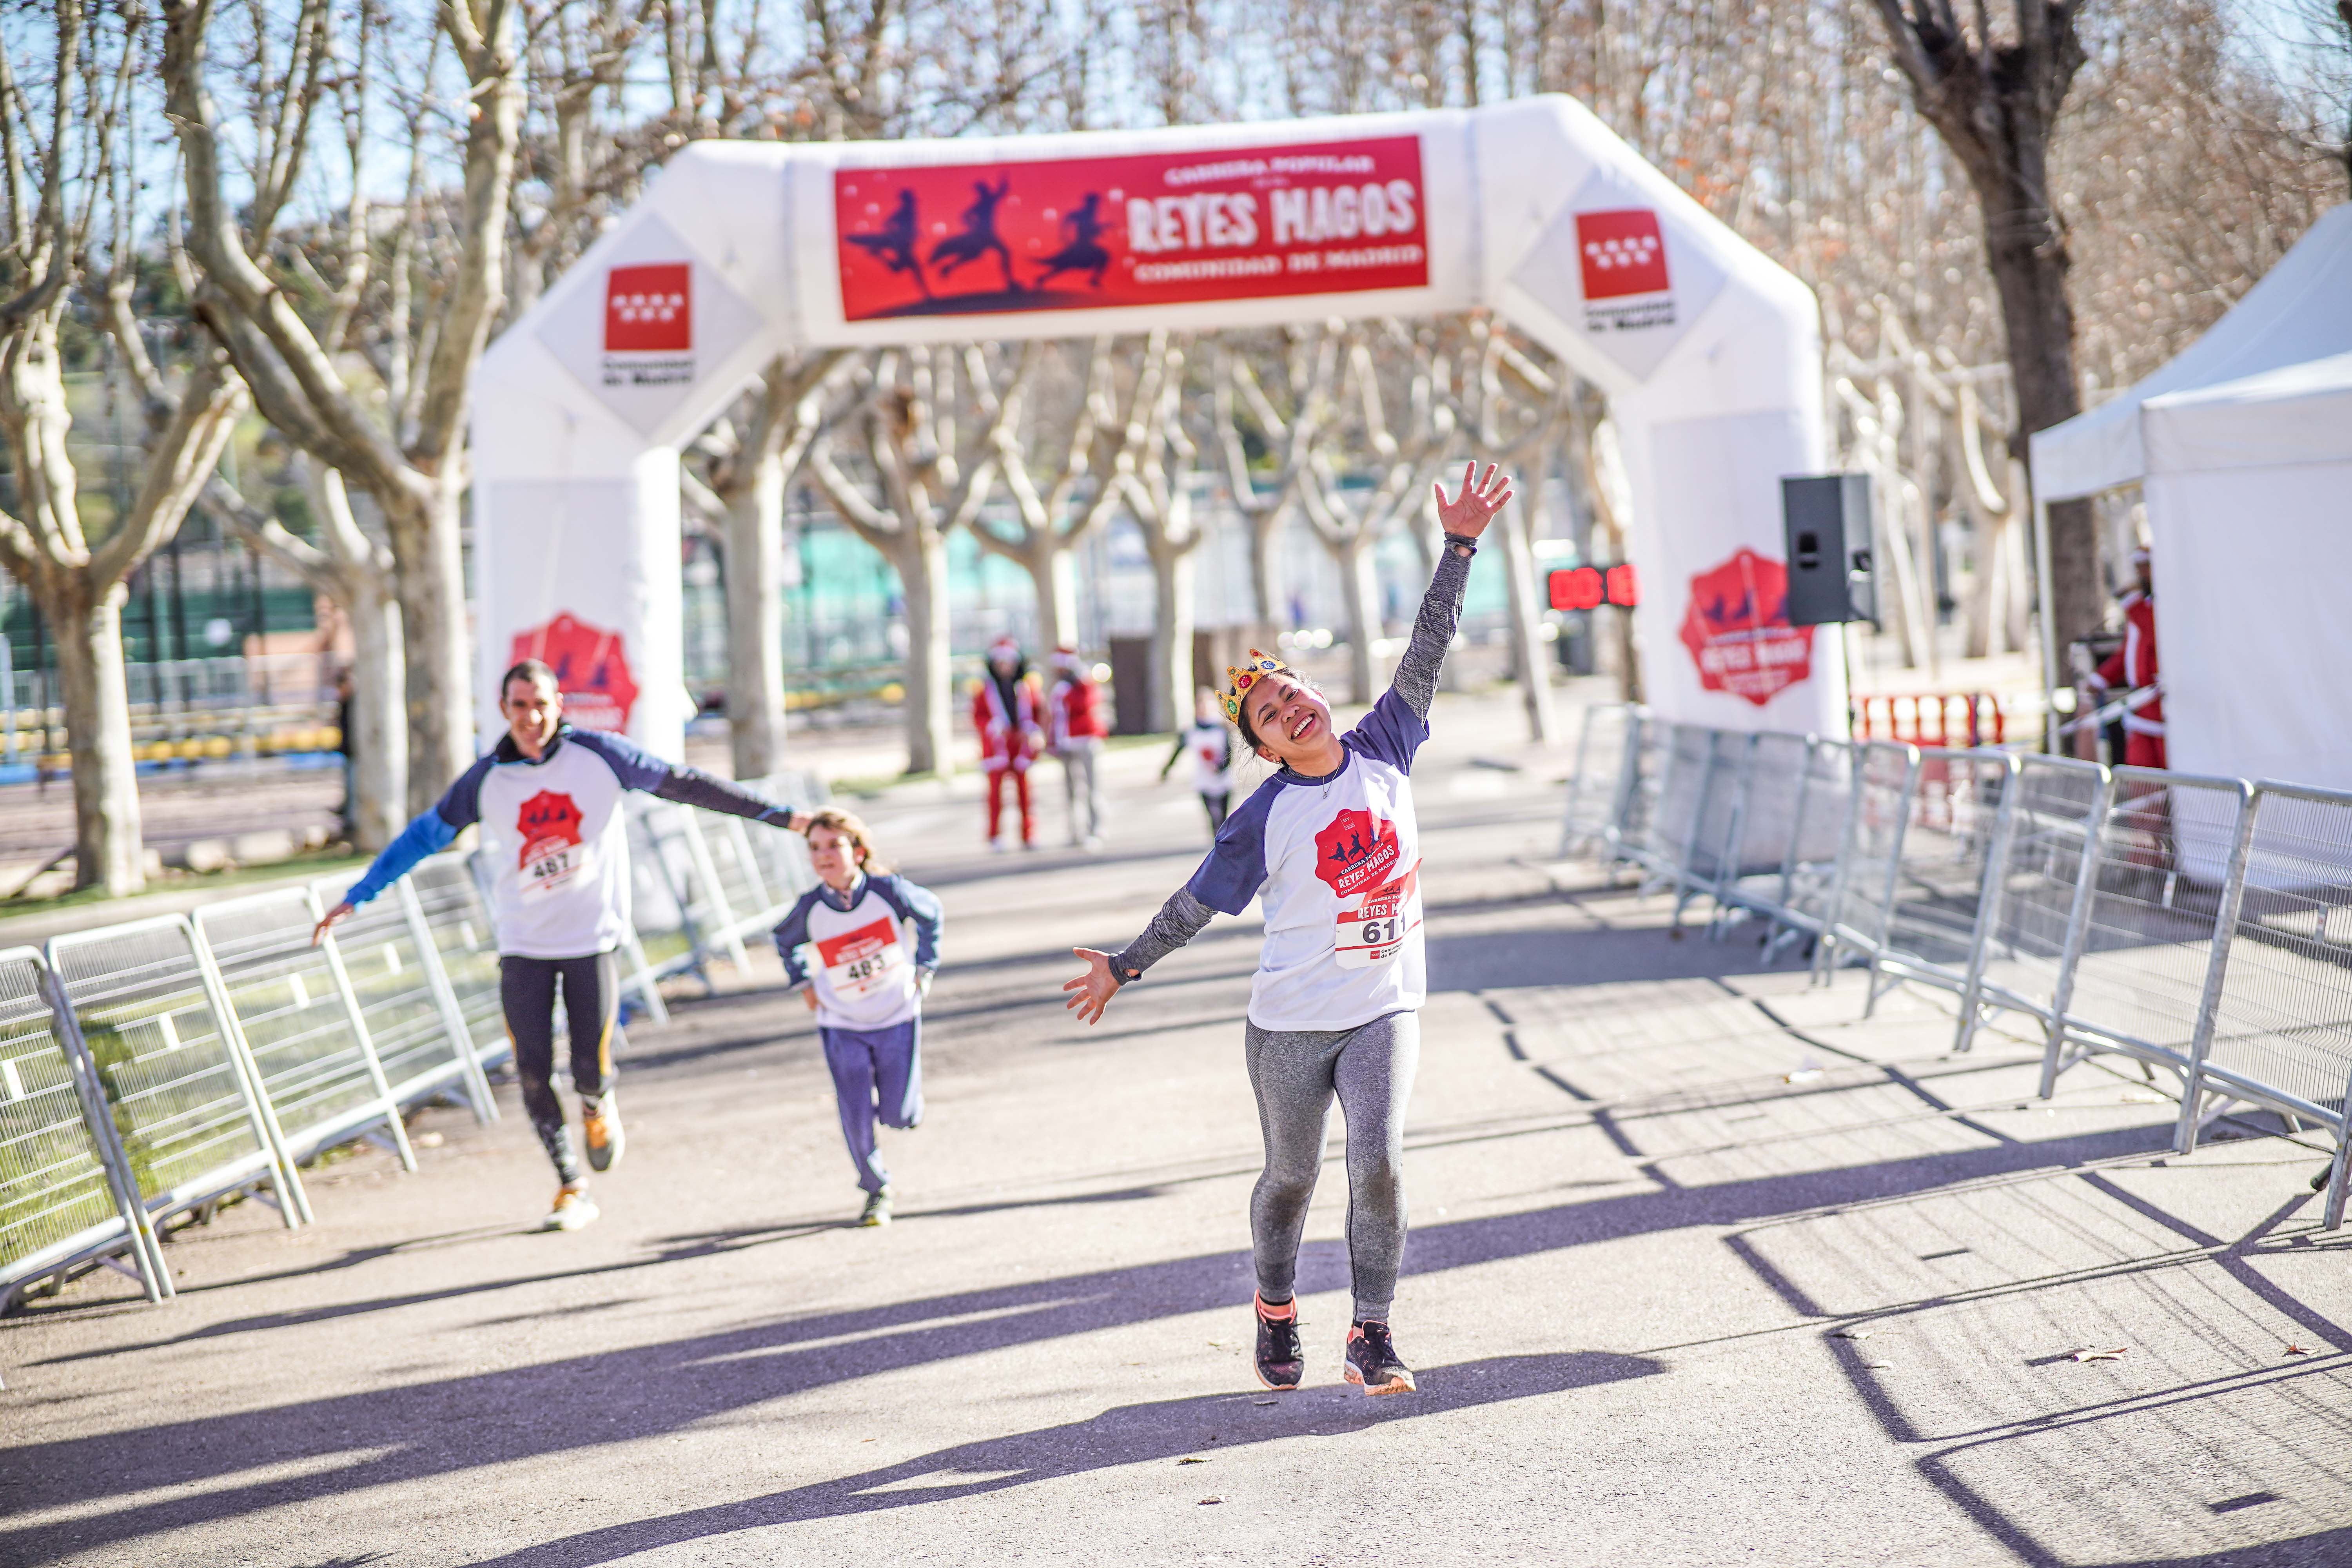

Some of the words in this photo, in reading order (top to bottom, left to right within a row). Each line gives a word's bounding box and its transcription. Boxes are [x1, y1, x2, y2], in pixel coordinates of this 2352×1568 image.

[1127, 192, 1259, 254] REYES
[1270, 179, 1417, 246] MAGOS
[1338, 868, 1365, 889] REYES
[1367, 845, 1394, 872] MAGOS
[1341, 859, 1365, 875] CARRERA
[1341, 876, 1370, 895] COMUNIDAD
[1379, 858, 1398, 872] MADRID
[1358, 904, 1387, 919] REYES
